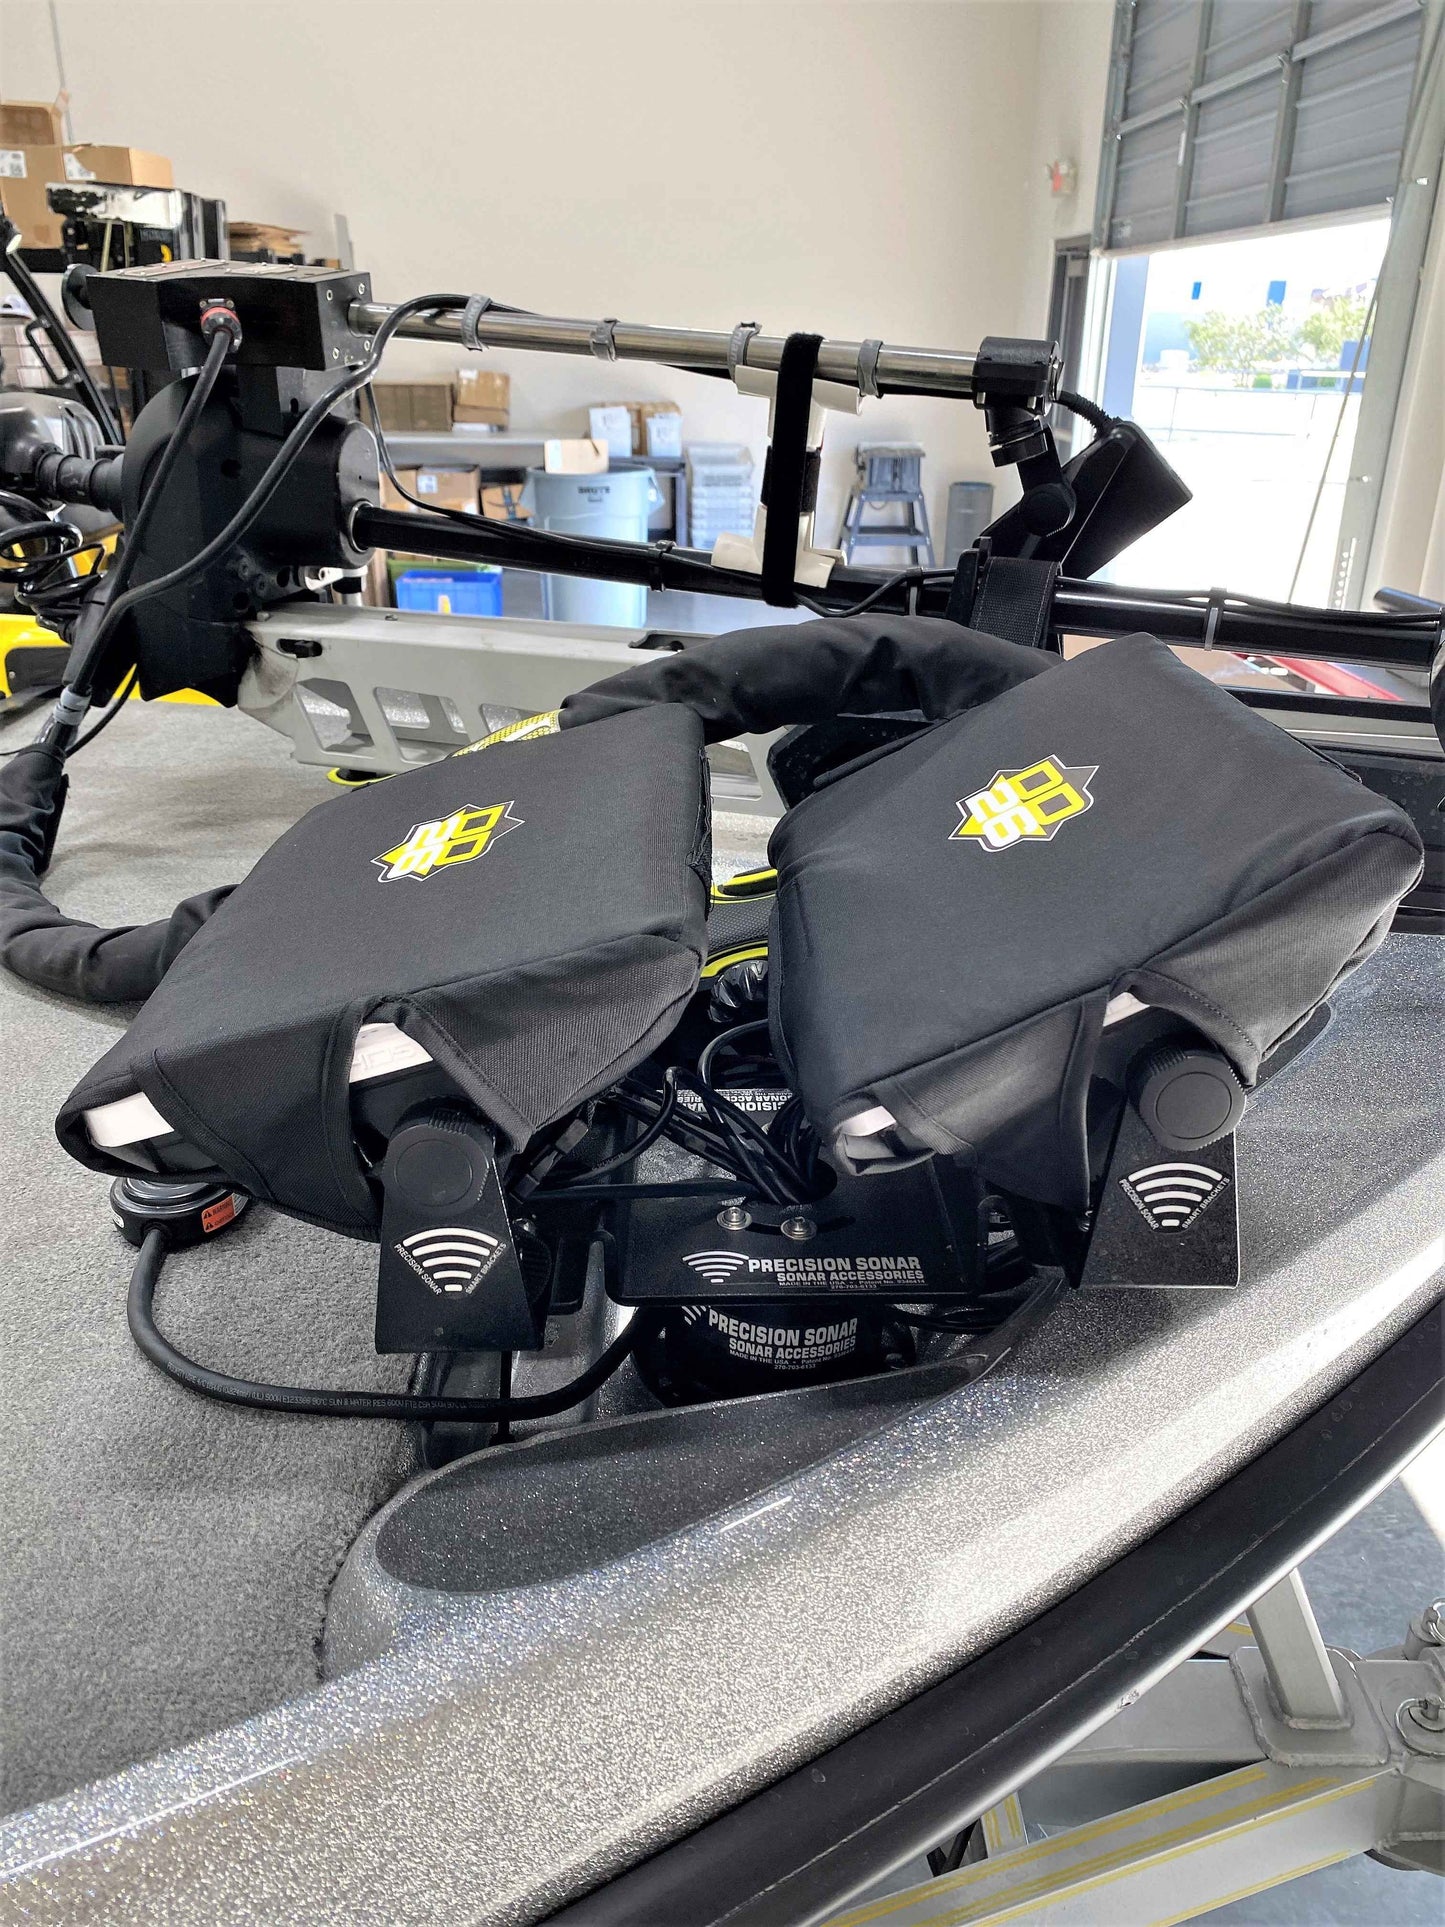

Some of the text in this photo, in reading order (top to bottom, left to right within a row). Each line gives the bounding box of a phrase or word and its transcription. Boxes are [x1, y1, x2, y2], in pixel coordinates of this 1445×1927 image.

[1118, 1178, 1160, 1230] PRECISION SONAR
[1181, 1177, 1231, 1229] SMART BRACKETS
[394, 1243, 443, 1296] PRECISION SONAR
[465, 1242, 508, 1295] SMART BRACKETS
[748, 1256, 921, 1273] PRECISION SONAR
[777, 1270, 925, 1282] SONAR ACCESSORIES
[708, 1308, 858, 1347] PRECISION SONAR
[728, 1335, 857, 1360] SONAR ACCESSORIES
[729, 1349, 749, 1360] MADE
